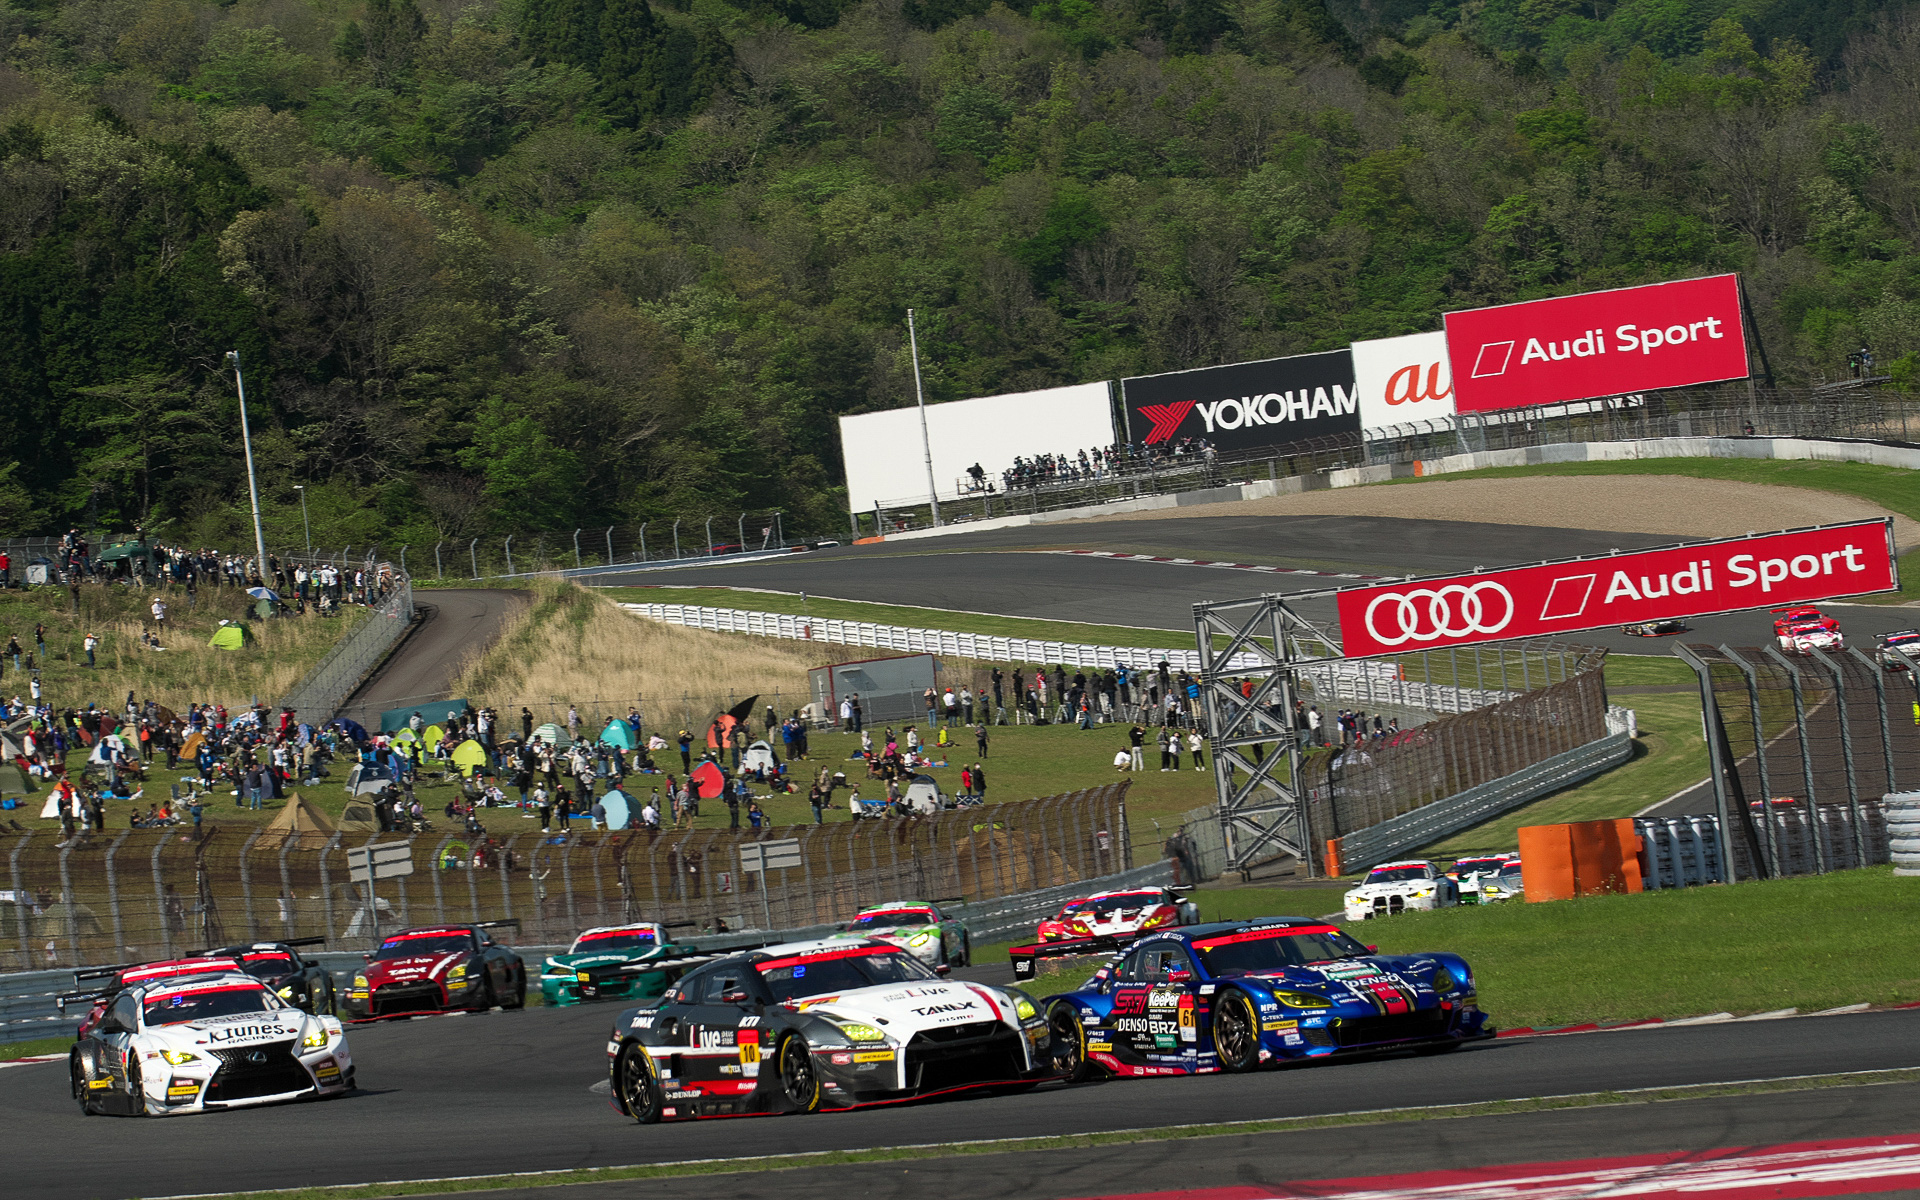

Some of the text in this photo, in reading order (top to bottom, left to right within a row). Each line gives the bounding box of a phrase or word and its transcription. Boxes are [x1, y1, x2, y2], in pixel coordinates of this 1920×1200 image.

[1521, 317, 1724, 365] Audi Sport
[1603, 544, 1866, 605] Audi Sport
[1251, 923, 1290, 932] SUBARU
[1330, 967, 1378, 979] Panasonic
[1349, 973, 1399, 988] DENSO
[905, 987, 951, 998] Live
[1148, 989, 1181, 1008] KeePer
[1260, 1003, 1278, 1012] NPR
[1117, 1018, 1148, 1032] DENSO
[1183, 1010, 1196, 1027] 61
[1149, 1021, 1179, 1035] BRZ
[227, 1035, 274, 1045] RACING
[690, 1024, 721, 1050] Live
[743, 1045, 755, 1062] 10
[671, 1090, 702, 1099] DUNLOP
